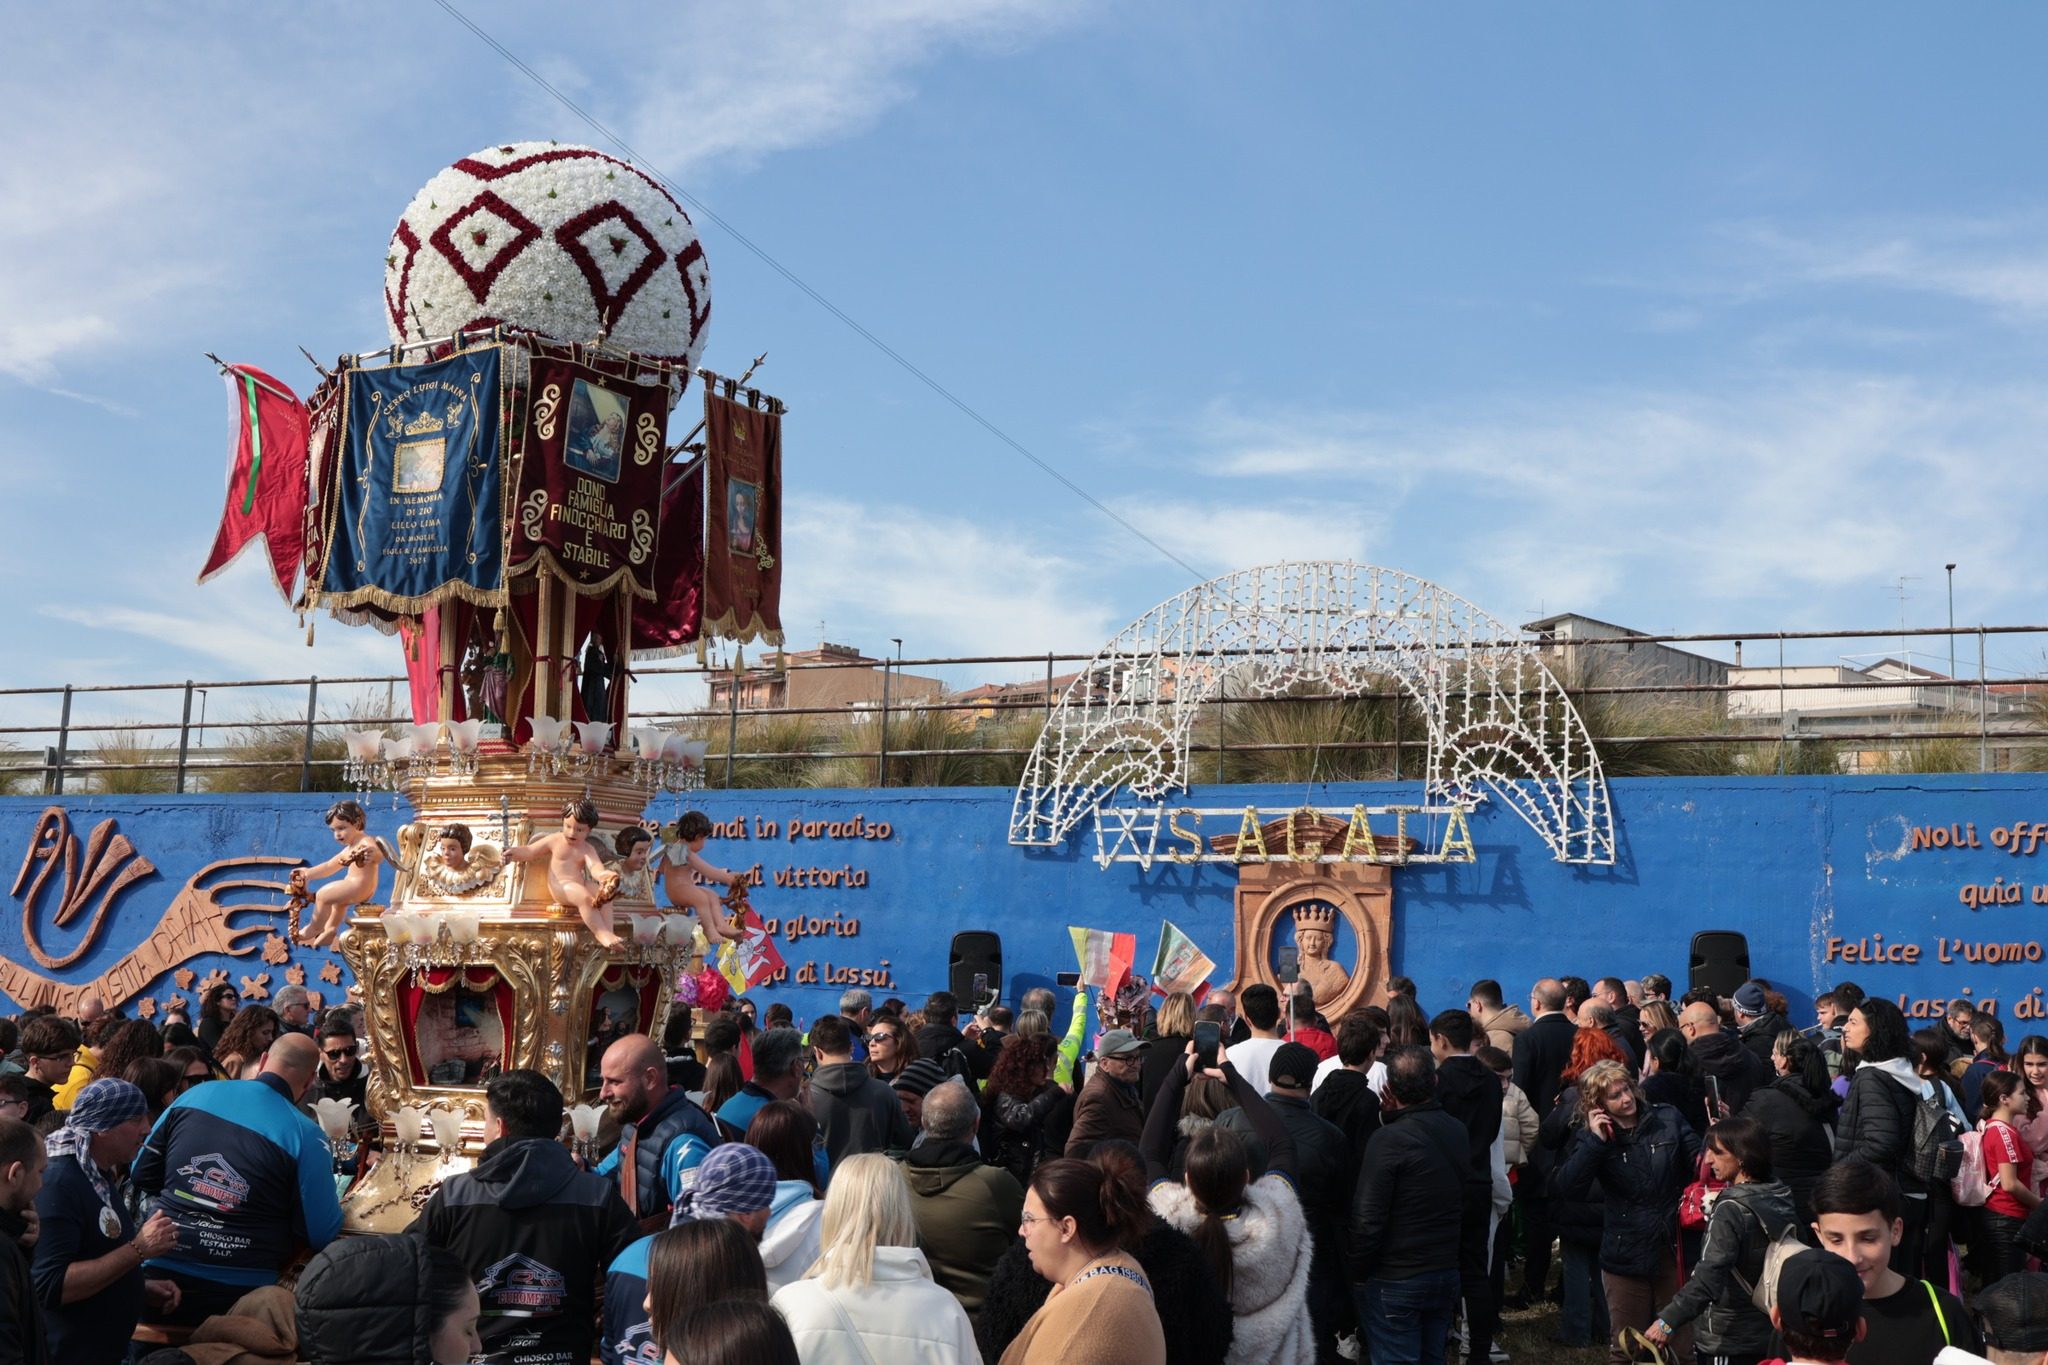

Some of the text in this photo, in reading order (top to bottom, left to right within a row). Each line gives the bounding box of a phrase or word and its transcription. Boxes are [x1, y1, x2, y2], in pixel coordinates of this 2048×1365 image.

[383, 381, 468, 415] CEREO LUIGI MAINA
[389, 493, 444, 505] IN MEMORIA
[577, 476, 606, 501] DONO
[406, 508, 416, 516] DI
[567, 489, 616, 521] FAMIGLIA
[391, 518, 442, 530] LILLO LIMA
[550, 503, 628, 540] FINOCCHIARO
[585, 530, 594, 547] E
[562, 541, 611, 569] STABILE
[754, 815, 777, 838] in
[787, 813, 892, 840] paradiso
[1911, 821, 2048, 854] Noli off
[773, 864, 867, 887] vittoria
[1959, 876, 2022, 909] quia
[784, 911, 858, 942] gloria
[1826, 932, 1921, 963] Felice
[795, 961, 818, 984] di
[199, 1230, 252, 1246] CHIOSCO BAR
[513, 1351, 574, 1364] CHIOSCO BAR
